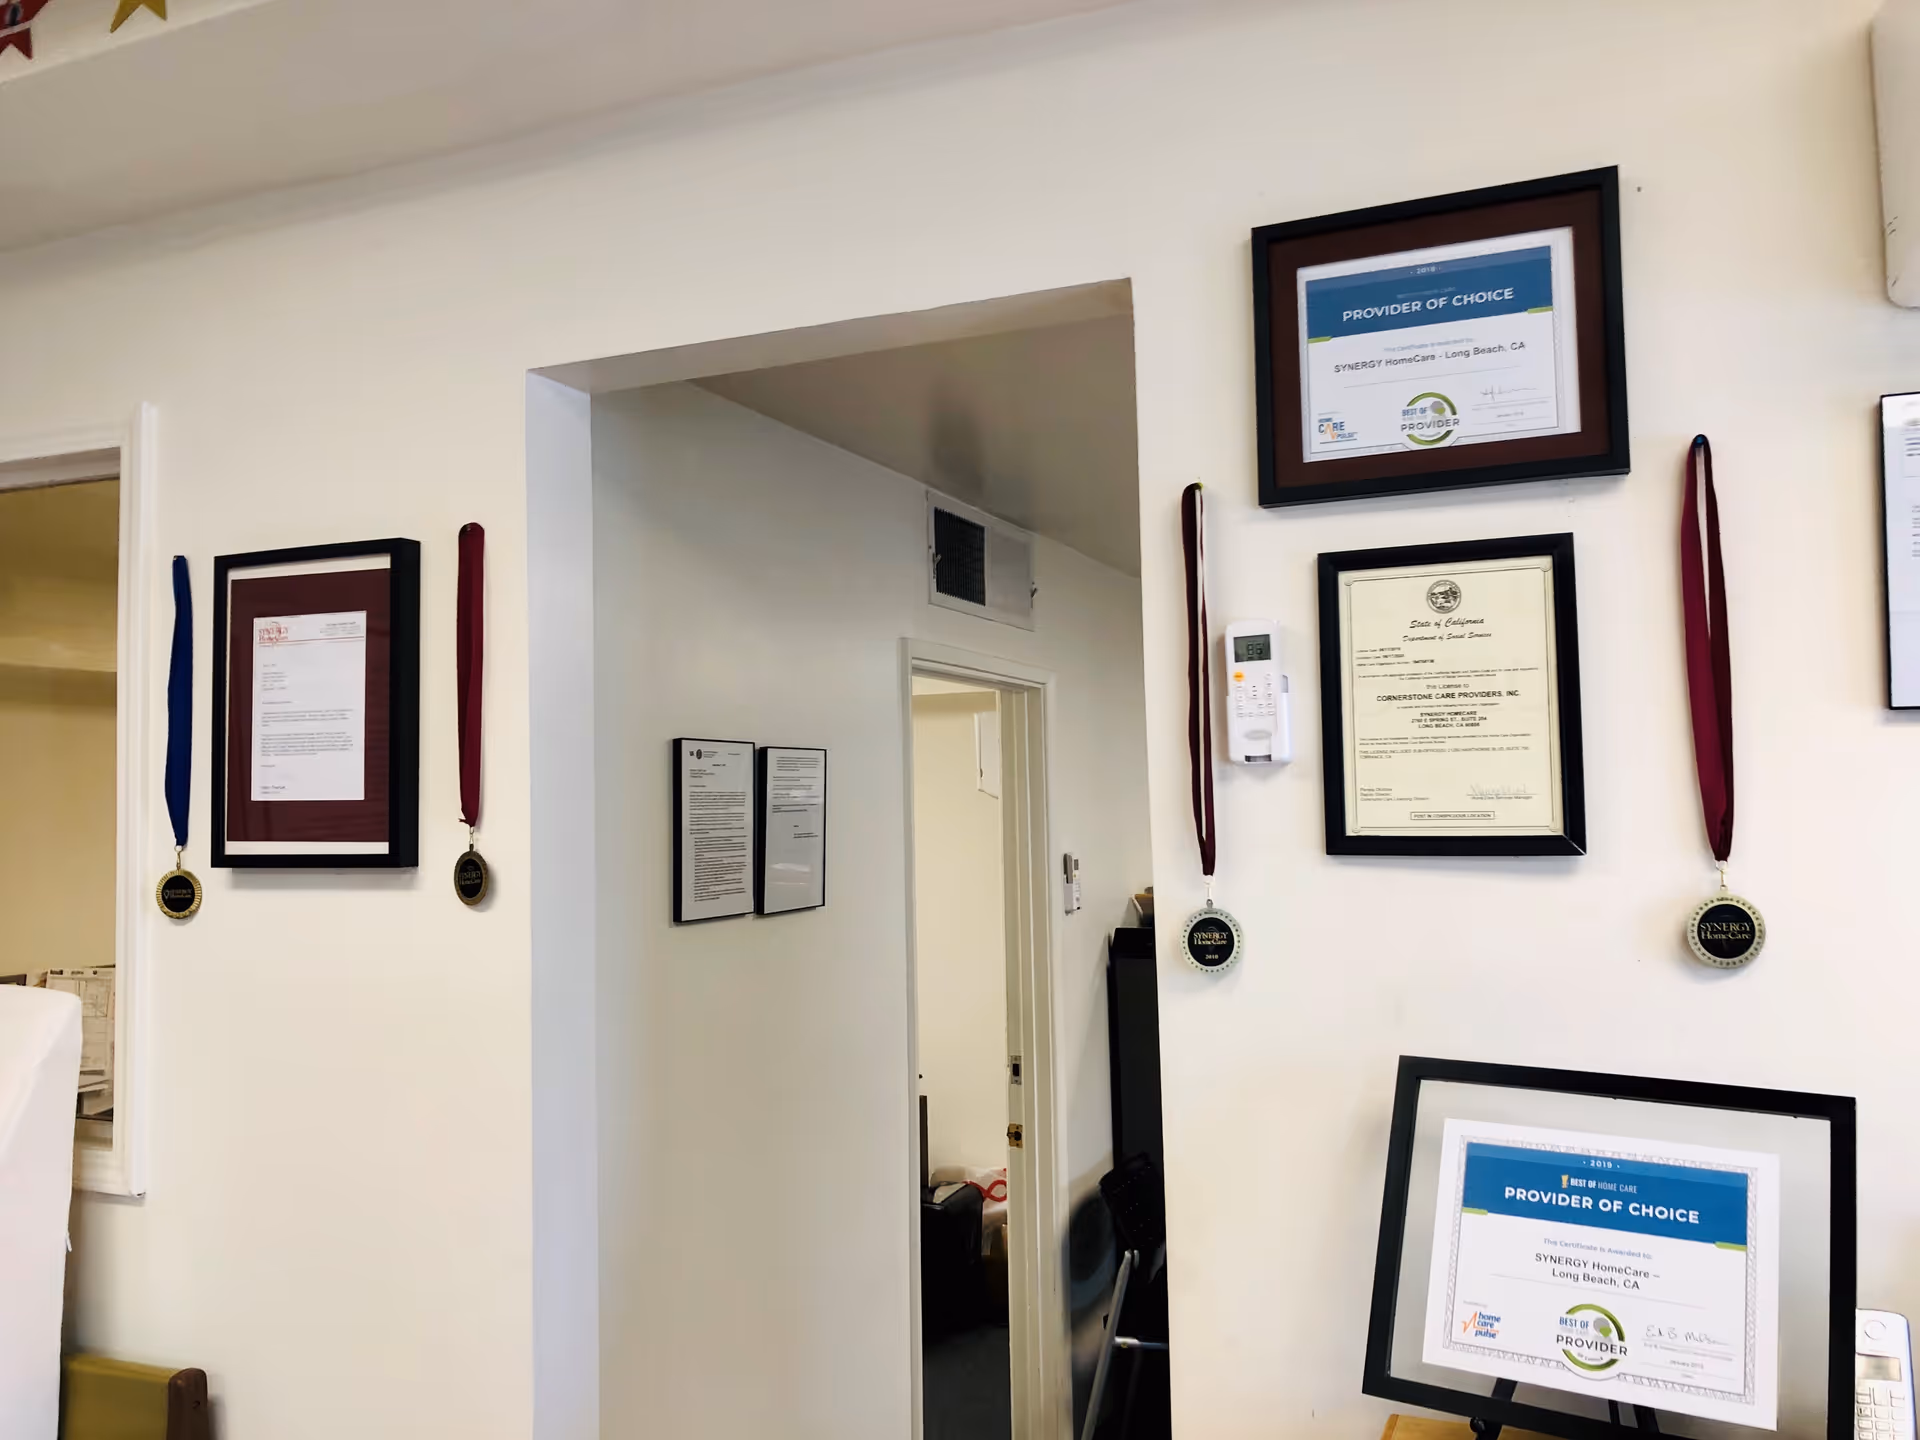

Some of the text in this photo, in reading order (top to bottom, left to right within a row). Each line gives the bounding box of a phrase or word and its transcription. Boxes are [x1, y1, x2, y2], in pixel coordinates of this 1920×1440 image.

[1342, 301, 1422, 322] PROVIDER
[1425, 296, 1448, 310] OF
[1452, 287, 1514, 306] CHOICE
[1334, 359, 1382, 373] SYNERGY
[1385, 353, 1435, 367] HomeCare
[1445, 350, 1470, 360] Long
[1510, 341, 1526, 351] CA
[1402, 406, 1428, 417] BEST OF
[1401, 417, 1460, 432] PROVIDER
[1409, 617, 1484, 628] State of California
[1402, 634, 1436, 642] Department
[1376, 693, 1433, 702] CORNERSTONE
[1435, 692, 1456, 700] CARE
[1506, 690, 1521, 698] INC.
[1700, 922, 1752, 932] SYNERGY
[1701, 931, 1752, 940] HomeCare
[1590, 1159, 1613, 1169] 2019
[1570, 1177, 1638, 1194] BEST OF HOME CARE
[1504, 1186, 1700, 1224] PROVIDER OF CHOICE
[1559, 1239, 1598, 1252] Certificate
[1535, 1252, 1589, 1269] SYNERGY
[1592, 1261, 1650, 1279] HomeCare
[1552, 1267, 1641, 1290] Long Beach, CA
[1478, 1311, 1501, 1323] home
[1559, 1316, 1589, 1329] BEST OF
[1477, 1320, 1494, 1329] care
[1474, 1329, 1497, 1339] pulse
[1556, 1334, 1628, 1356] PROVIDER
